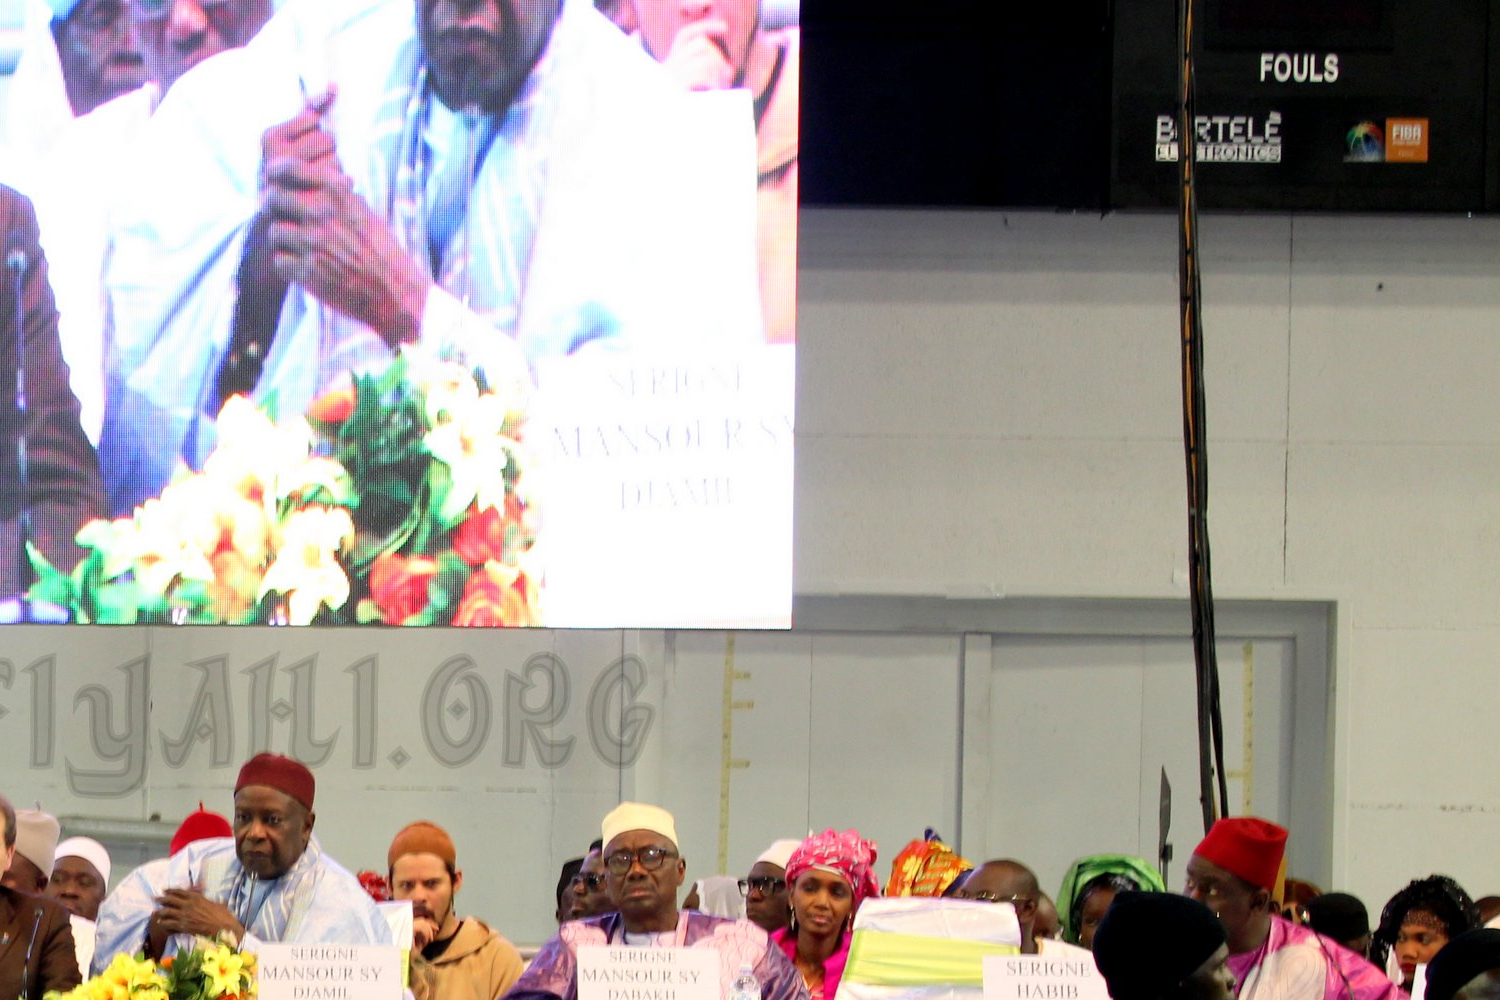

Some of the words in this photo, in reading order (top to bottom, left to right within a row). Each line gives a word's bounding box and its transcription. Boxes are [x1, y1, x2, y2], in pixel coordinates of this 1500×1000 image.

[1260, 53, 1339, 83] FOULS
[1156, 110, 1282, 144] BRTELÉ
[1392, 123, 1421, 140] FIBA
[550, 415, 746, 462] MANSOUR
[291, 946, 358, 961] SERIGNE
[610, 950, 676, 965] SERIGNE
[263, 965, 355, 982] MANSOUR
[360, 966, 382, 982] SY
[582, 967, 674, 984] MANSOUR
[679, 968, 700, 984] SY
[1006, 960, 1092, 978] SERIGNE
[293, 985, 353, 1000] DJAMIL
[1017, 983, 1079, 1000] HABIB
